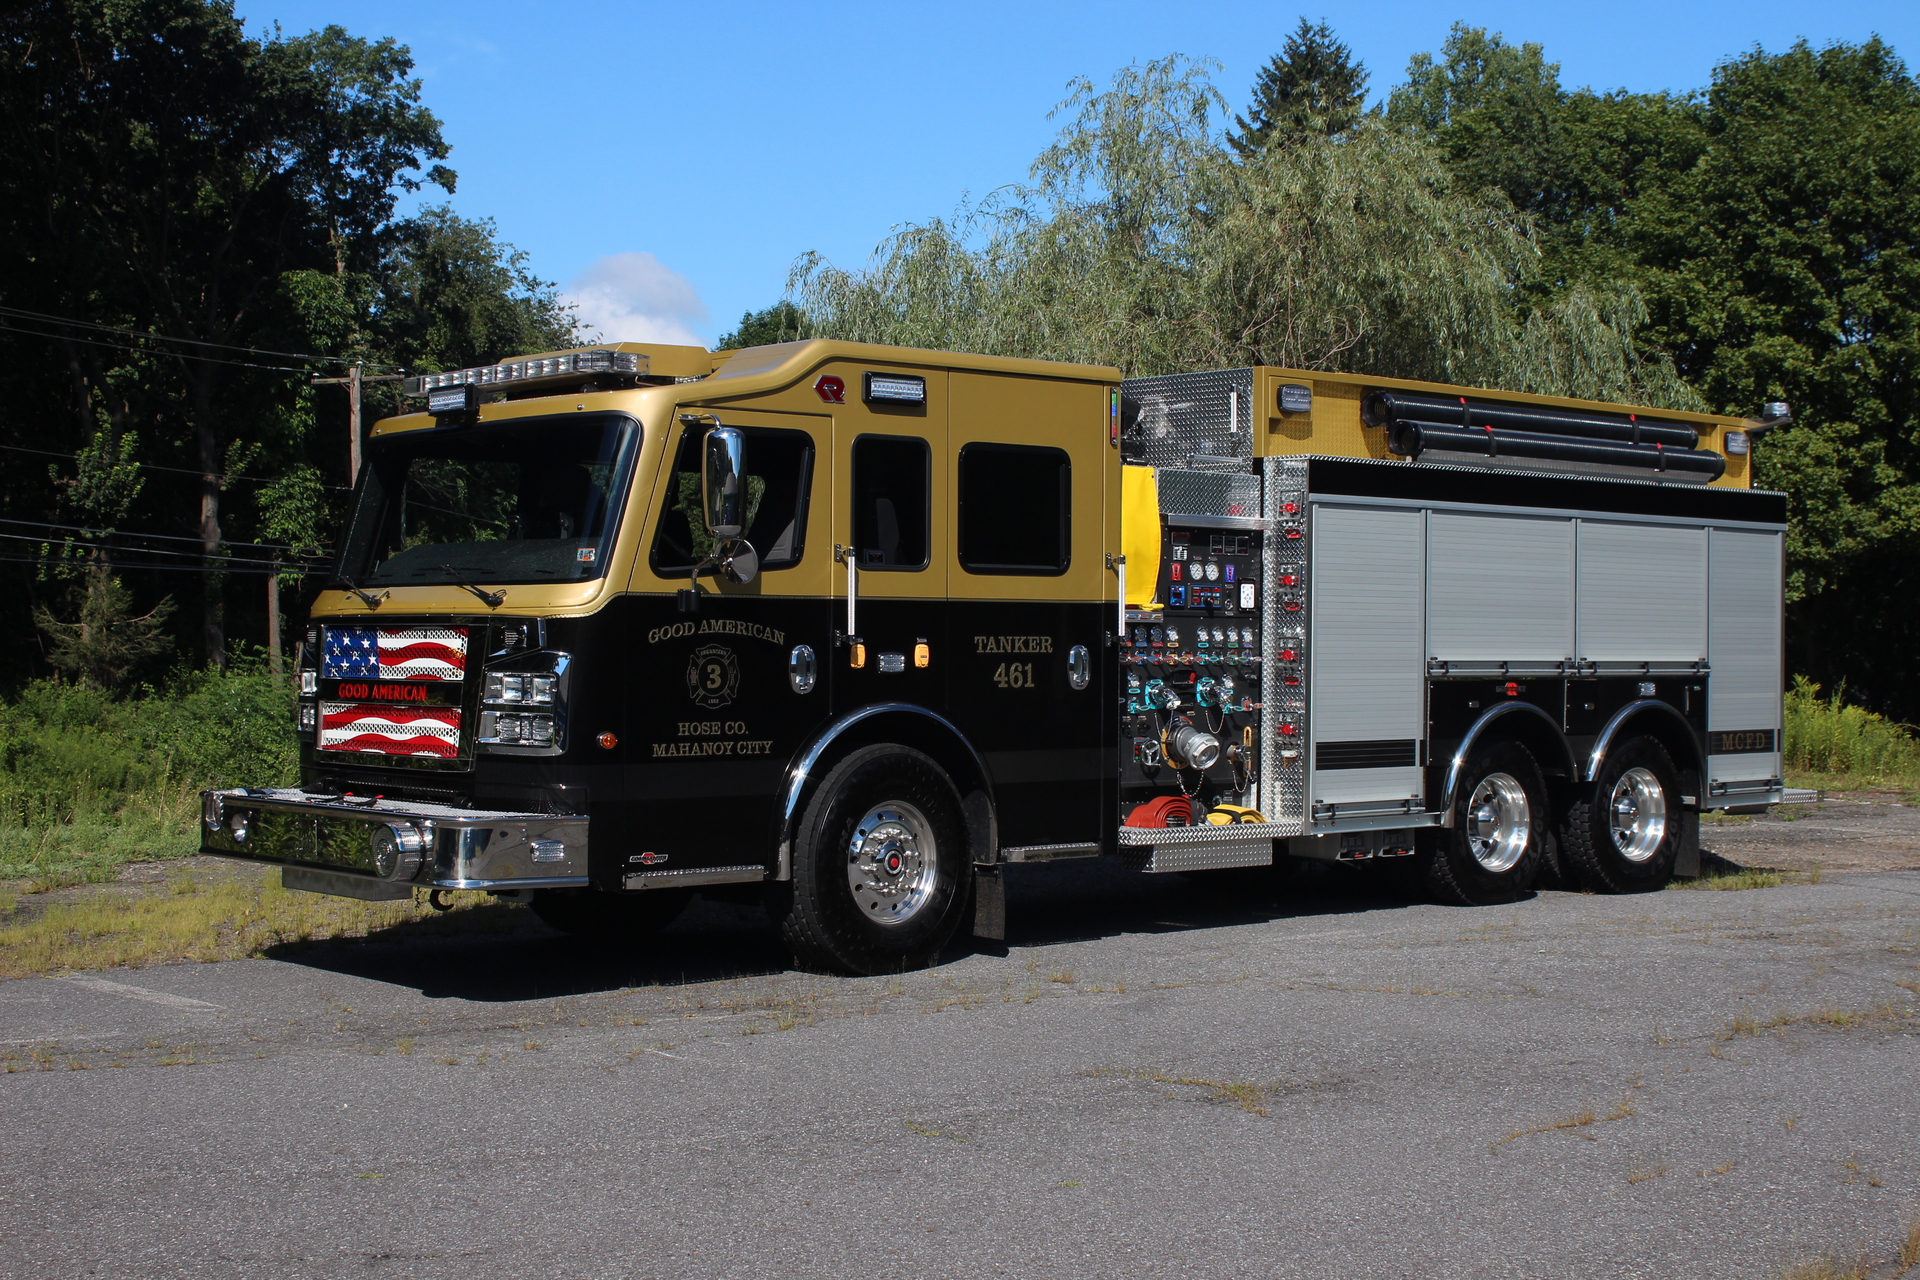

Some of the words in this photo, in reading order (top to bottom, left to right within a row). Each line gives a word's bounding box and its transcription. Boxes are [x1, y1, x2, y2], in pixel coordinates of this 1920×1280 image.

[648, 621, 696, 644] GOOD
[698, 619, 786, 645] AMERICAN
[974, 636, 1053, 653] TANKER
[706, 664, 722, 689] 3
[993, 662, 1035, 688] 461
[338, 683, 369, 699] GOOD
[371, 684, 427, 701] AMERICAN
[677, 722, 721, 736] HOSE
[725, 721, 749, 735] CO.
[652, 741, 734, 757] MAHANOY
[737, 740, 773, 755] CITY
[1721, 732, 1766, 751] MCFD
